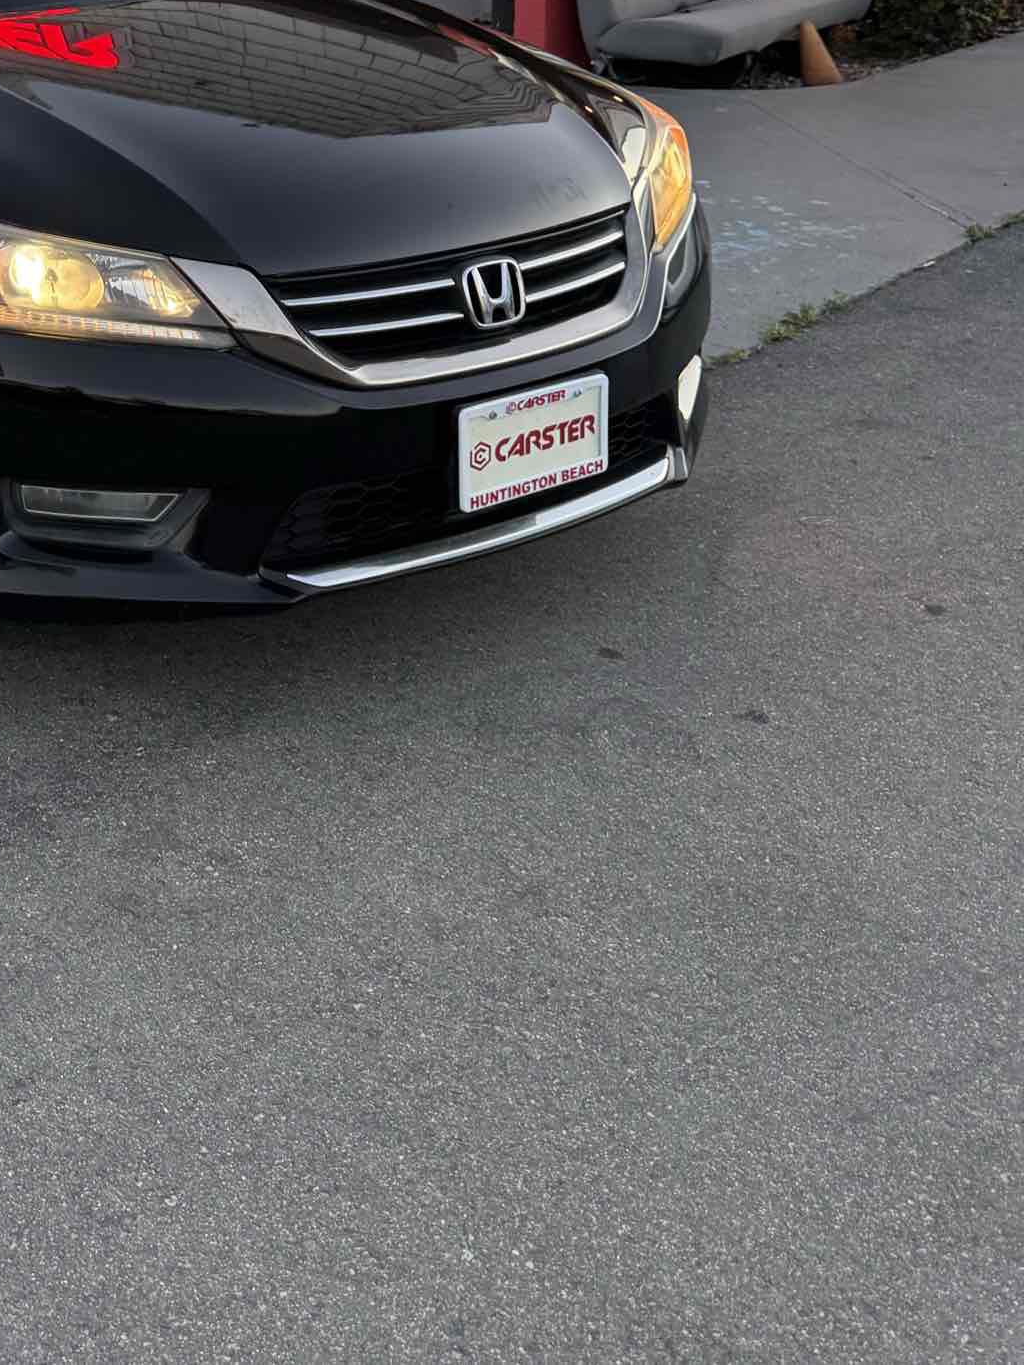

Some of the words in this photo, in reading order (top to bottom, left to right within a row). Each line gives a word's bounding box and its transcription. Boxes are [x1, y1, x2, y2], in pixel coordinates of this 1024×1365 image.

[517, 389, 566, 411] CARSTER
[494, 414, 596, 462] CARSTER
[470, 473, 557, 510] HUNTINGTON
[560, 459, 604, 482] BEACH
